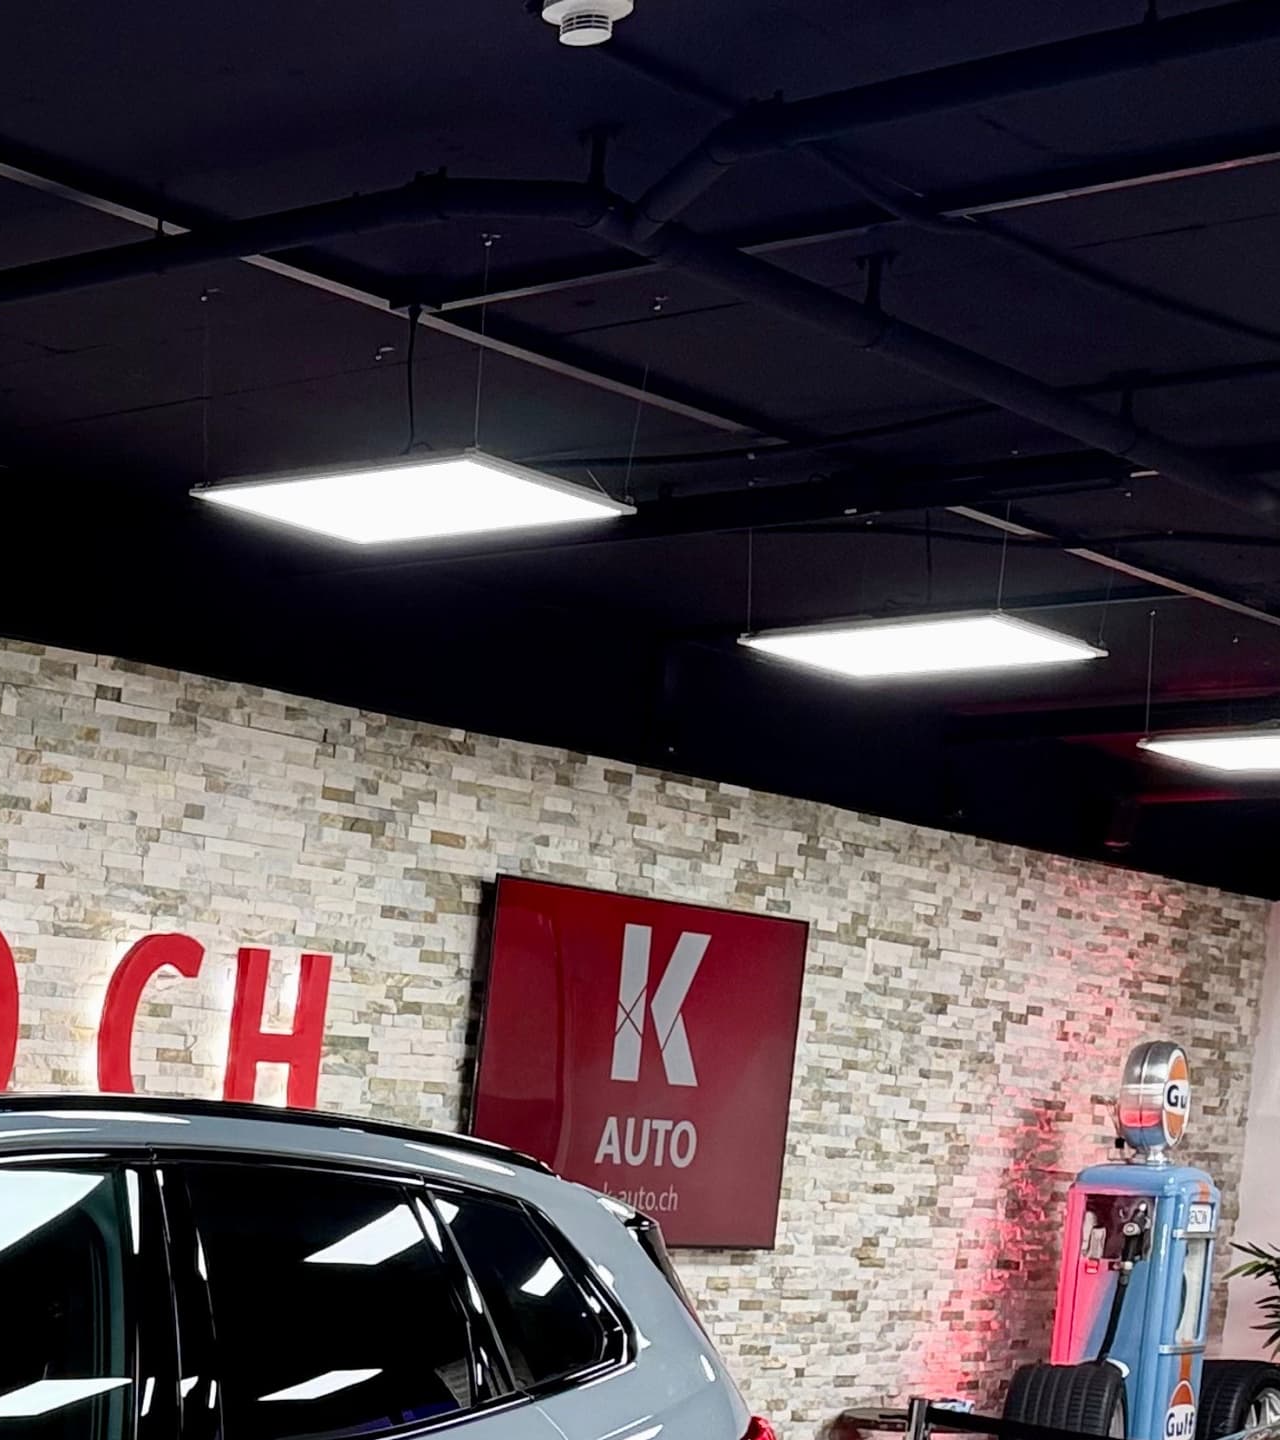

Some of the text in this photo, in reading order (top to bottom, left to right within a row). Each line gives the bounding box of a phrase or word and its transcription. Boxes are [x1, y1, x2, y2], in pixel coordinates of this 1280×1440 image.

[611, 923, 712, 1087] K
[594, 1116, 697, 1168] AUTO
[1166, 1411, 1195, 1438] Gulf
